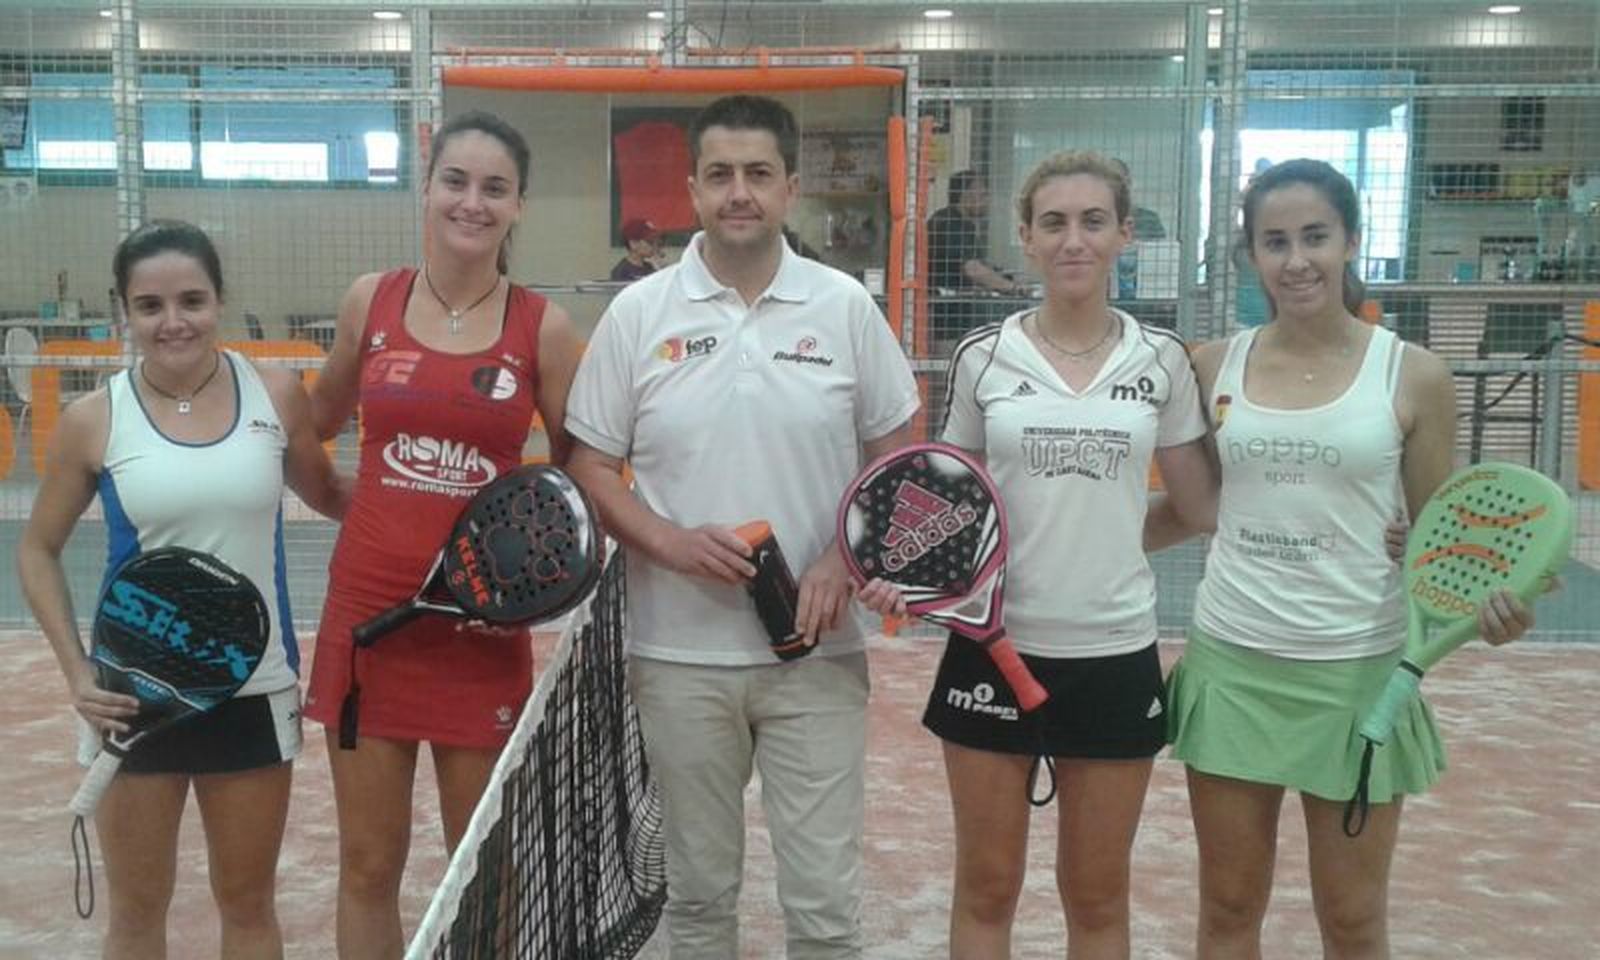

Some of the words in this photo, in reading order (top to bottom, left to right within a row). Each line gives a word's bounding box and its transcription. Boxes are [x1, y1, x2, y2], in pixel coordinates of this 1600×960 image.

[686, 335, 718, 355] fep
[397, 431, 479, 472] ROMA
[1022, 436, 1131, 482] UPCT
[436, 466, 467, 482] SPORT
[1264, 470, 1306, 486] sport
[882, 499, 977, 573] adidas
[456, 536, 490, 607] KELME
